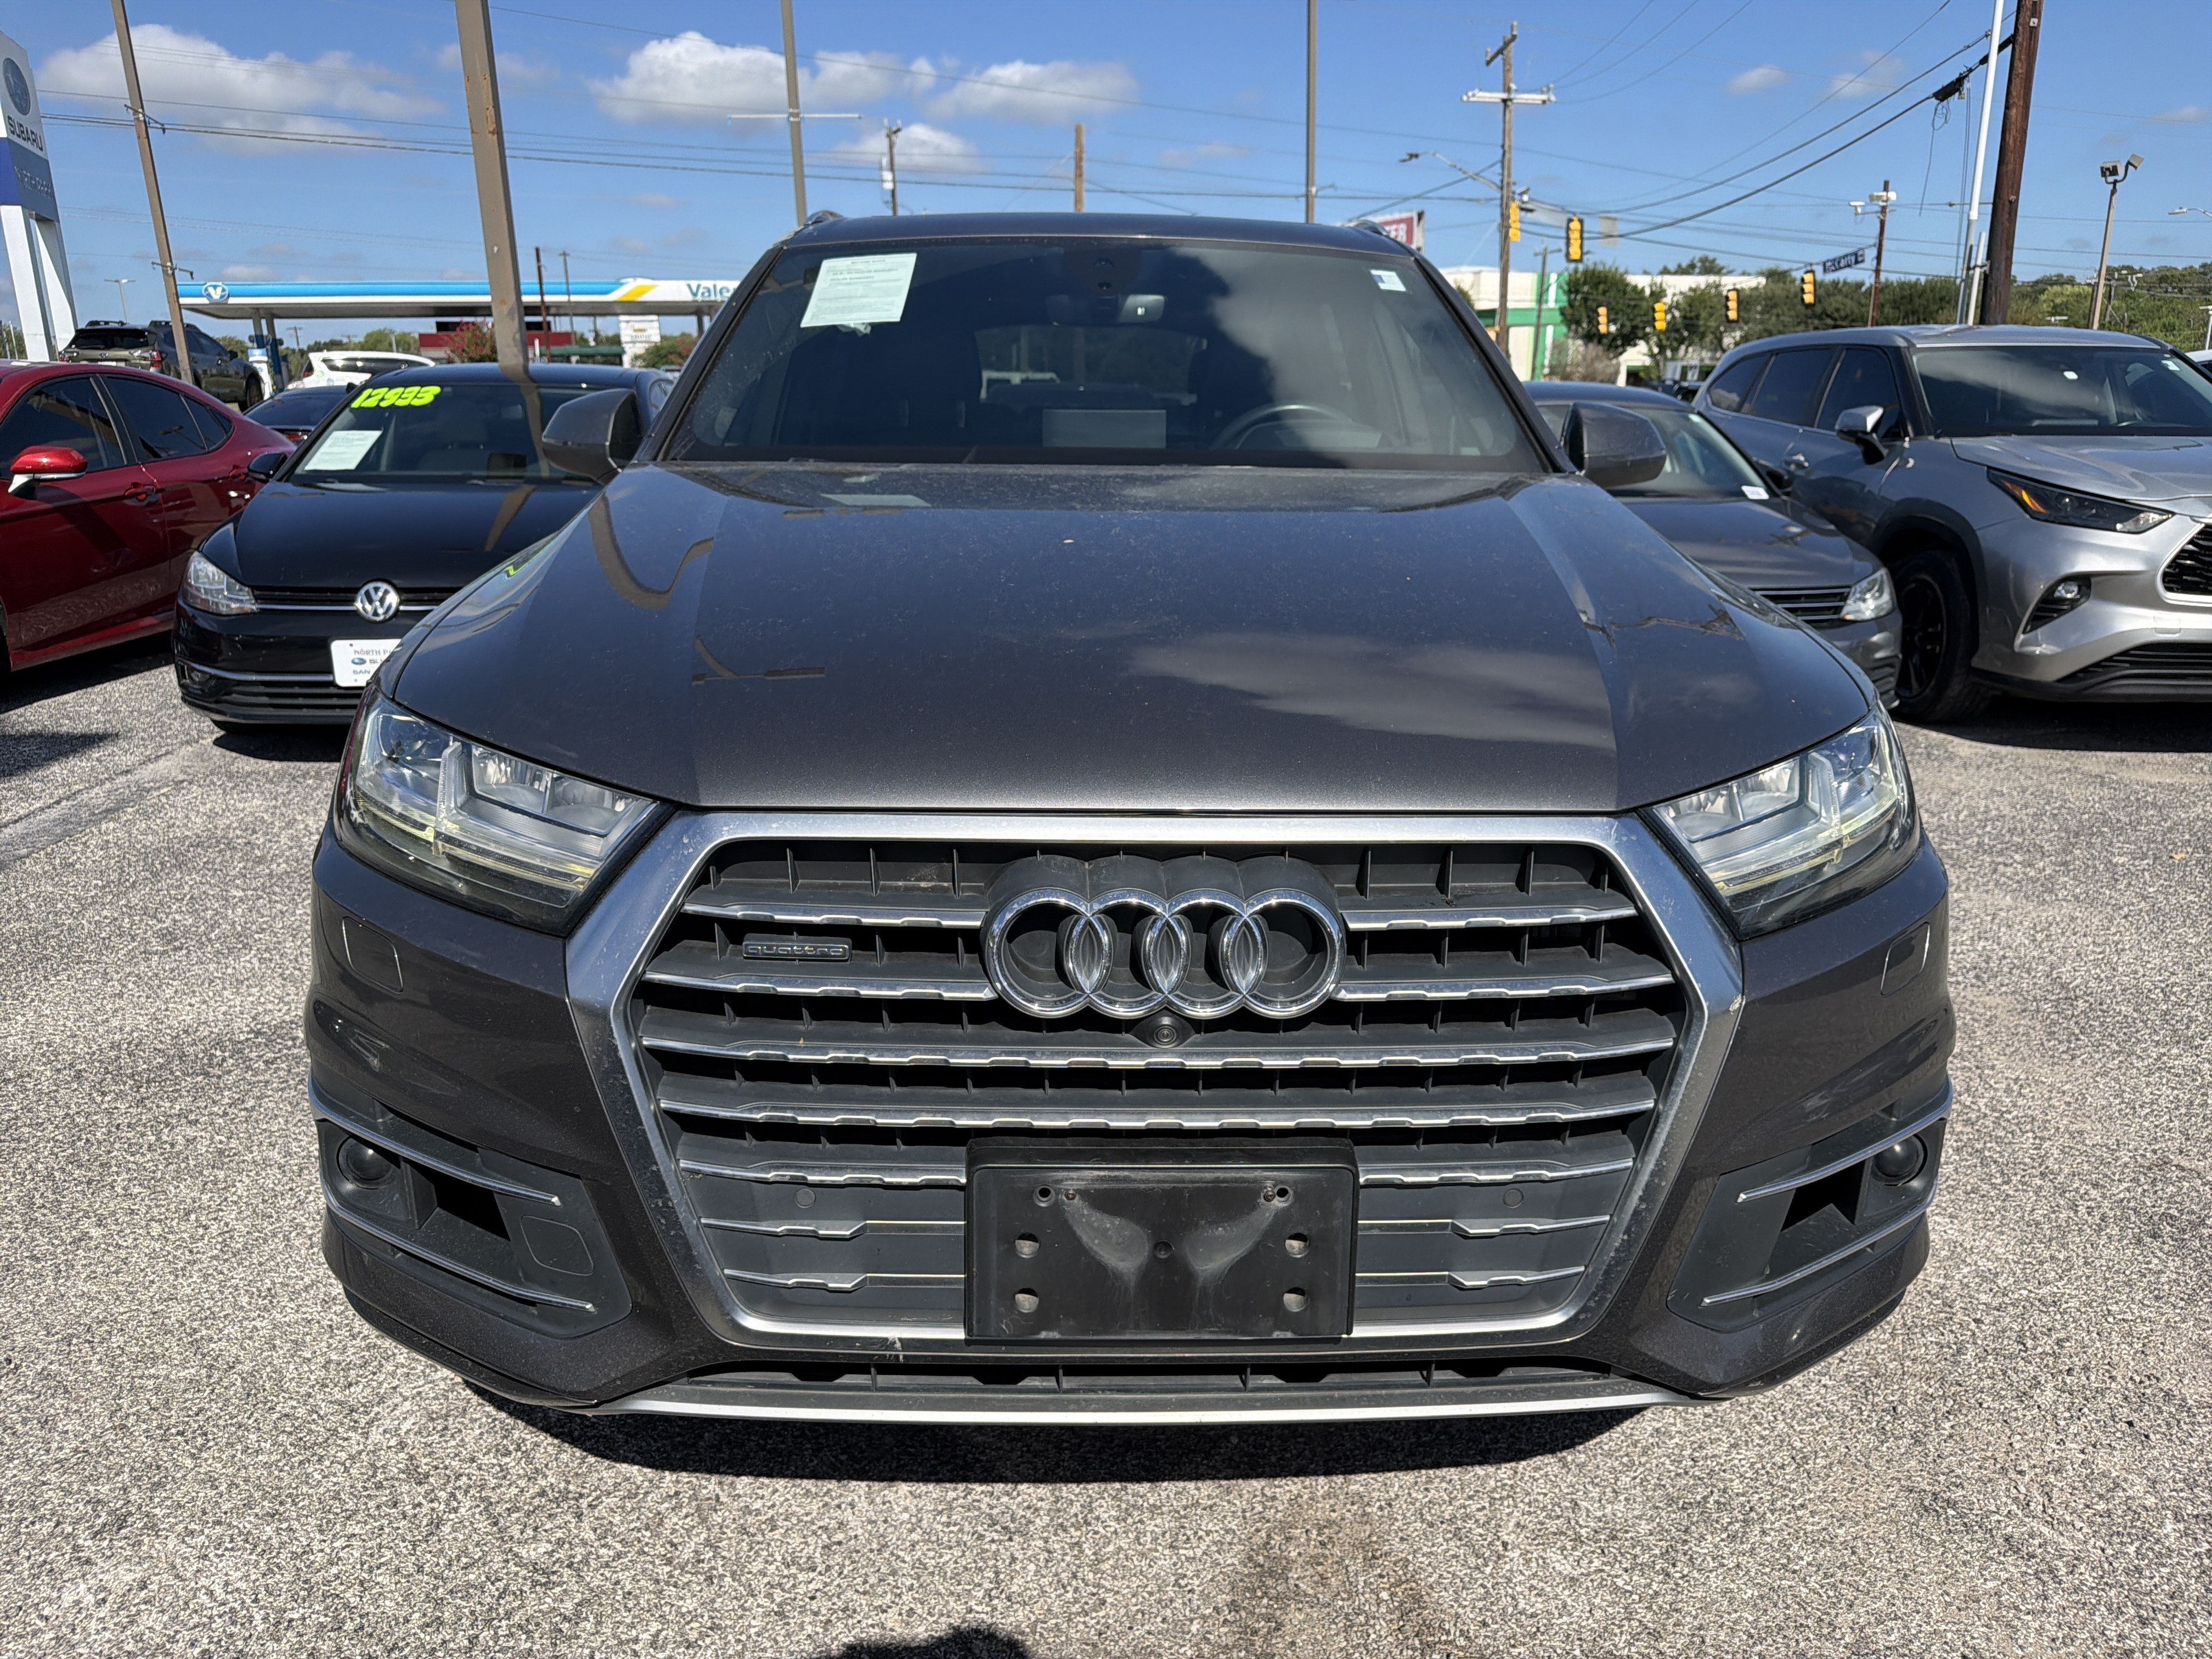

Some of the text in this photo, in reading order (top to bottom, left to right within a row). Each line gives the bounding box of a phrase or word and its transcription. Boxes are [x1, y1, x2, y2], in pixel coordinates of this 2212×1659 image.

[7, 115, 43, 152] SUBARU
[351, 386, 442, 409] 12933
[353, 648, 381, 656] NORTH
[747, 945, 844, 956] quattro
